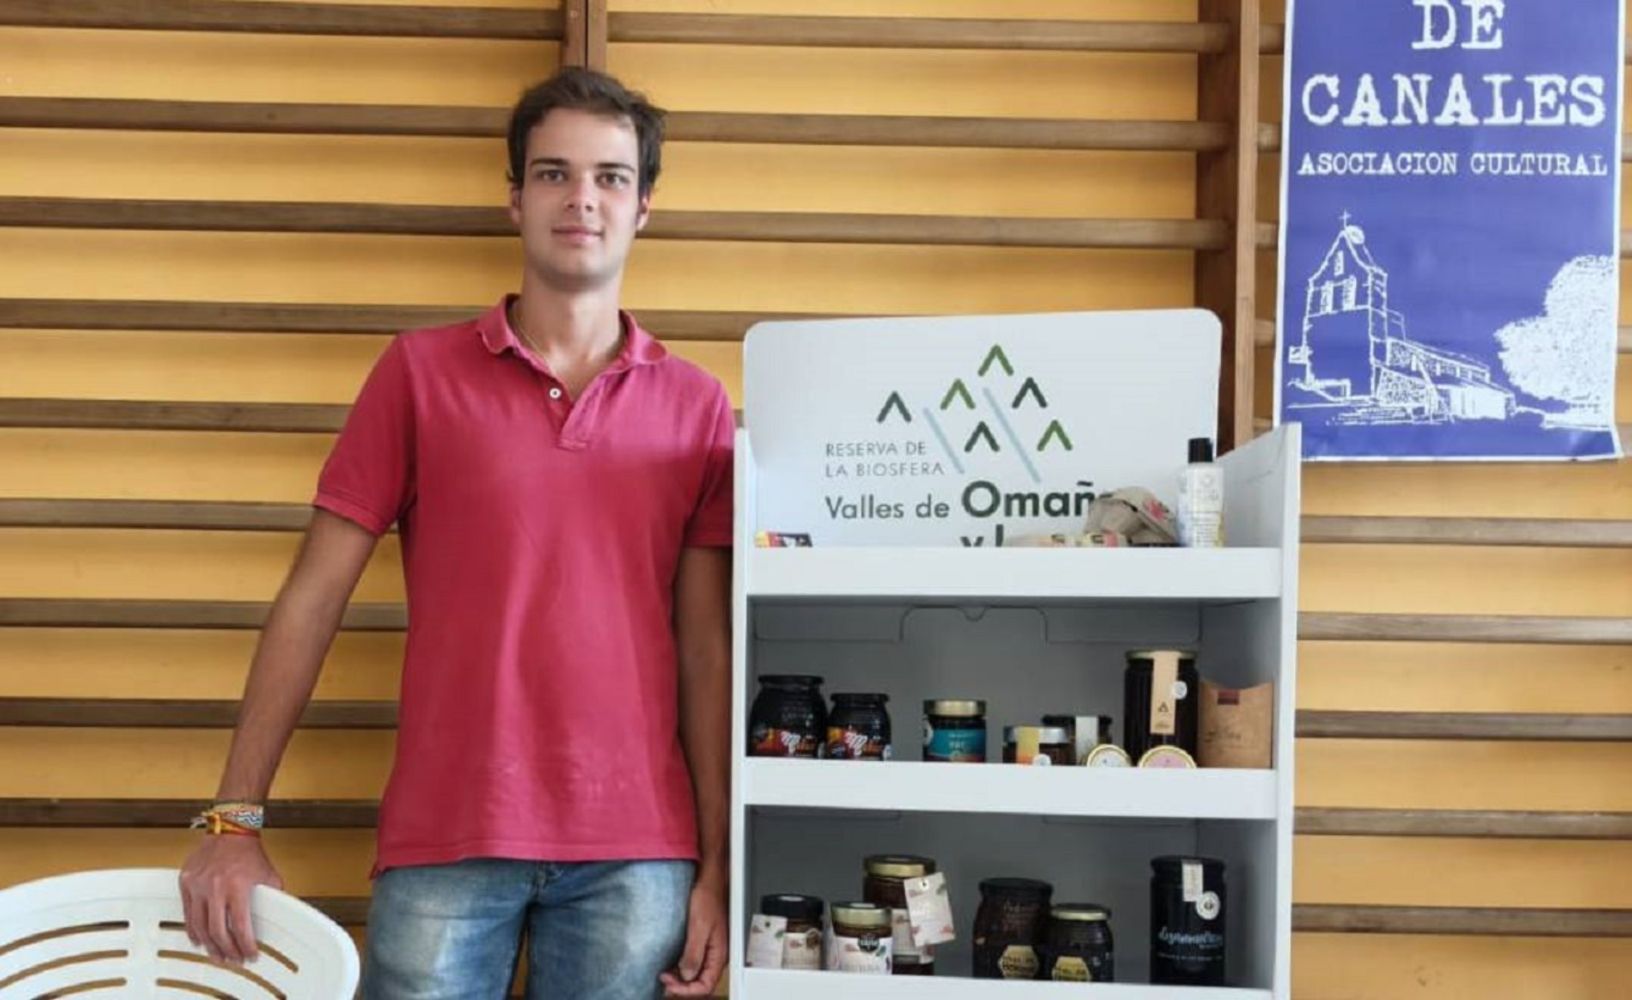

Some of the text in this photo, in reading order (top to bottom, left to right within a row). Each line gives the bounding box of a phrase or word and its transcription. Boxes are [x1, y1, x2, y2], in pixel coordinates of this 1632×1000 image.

[1411, 0, 1505, 49] DE
[1302, 73, 1607, 126] CANALES
[1297, 152, 1608, 176] ASOCIACION CULTURAL
[826, 441, 926, 457] RESERVA DE
[826, 462, 944, 478] LA BIOSFERA
[825, 480, 1096, 519] Valles de Omañ
